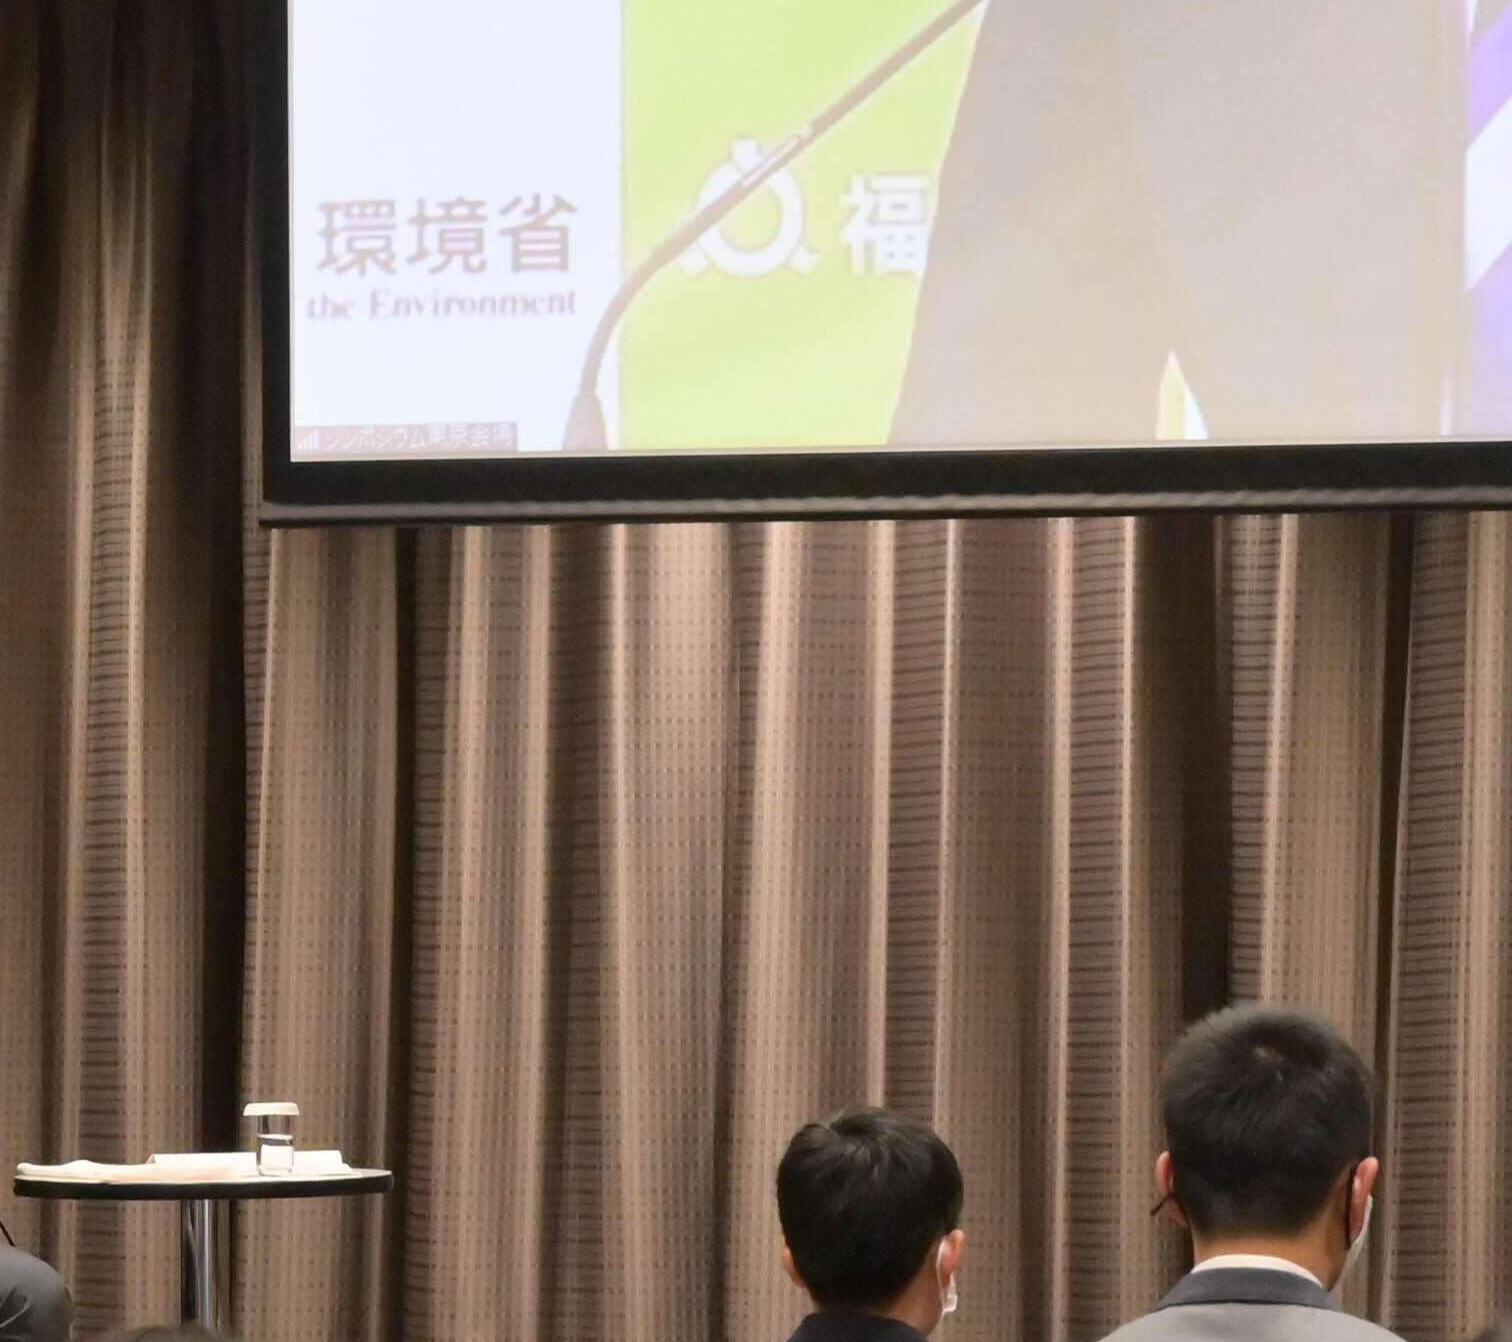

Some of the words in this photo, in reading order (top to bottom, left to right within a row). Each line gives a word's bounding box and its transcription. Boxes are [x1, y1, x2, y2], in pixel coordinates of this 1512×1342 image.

[317, 192, 579, 278] 環境省
[305, 291, 356, 320] the
[369, 288, 579, 319] Environment
